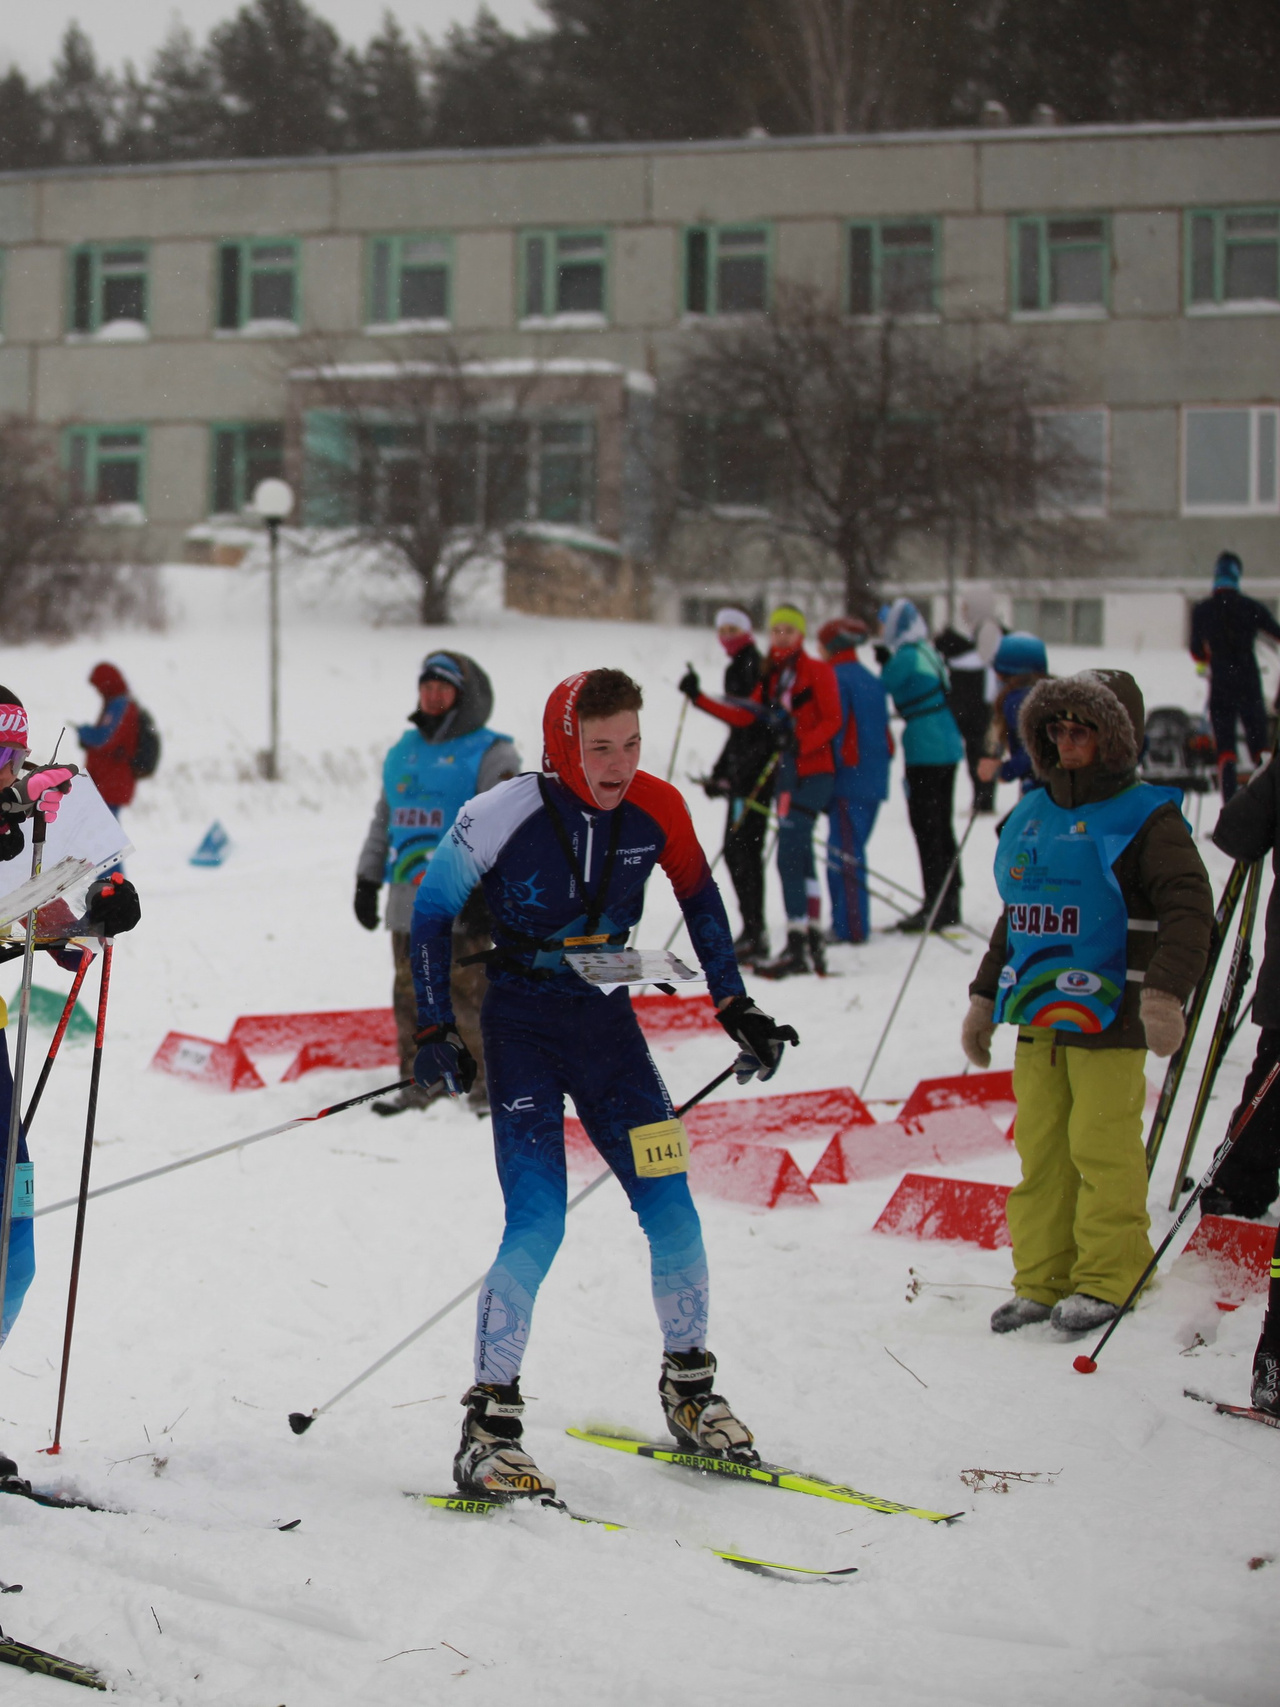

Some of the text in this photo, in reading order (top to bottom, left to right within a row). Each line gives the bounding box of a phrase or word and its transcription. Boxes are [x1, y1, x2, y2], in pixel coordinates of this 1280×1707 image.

[1008, 904, 1080, 936] СУДЬЯ
[645, 1142, 683, 1163] 114.1
[481, 1288, 495, 1335] VICTORY
[671, 1454, 752, 1476] CARBON SKATE
